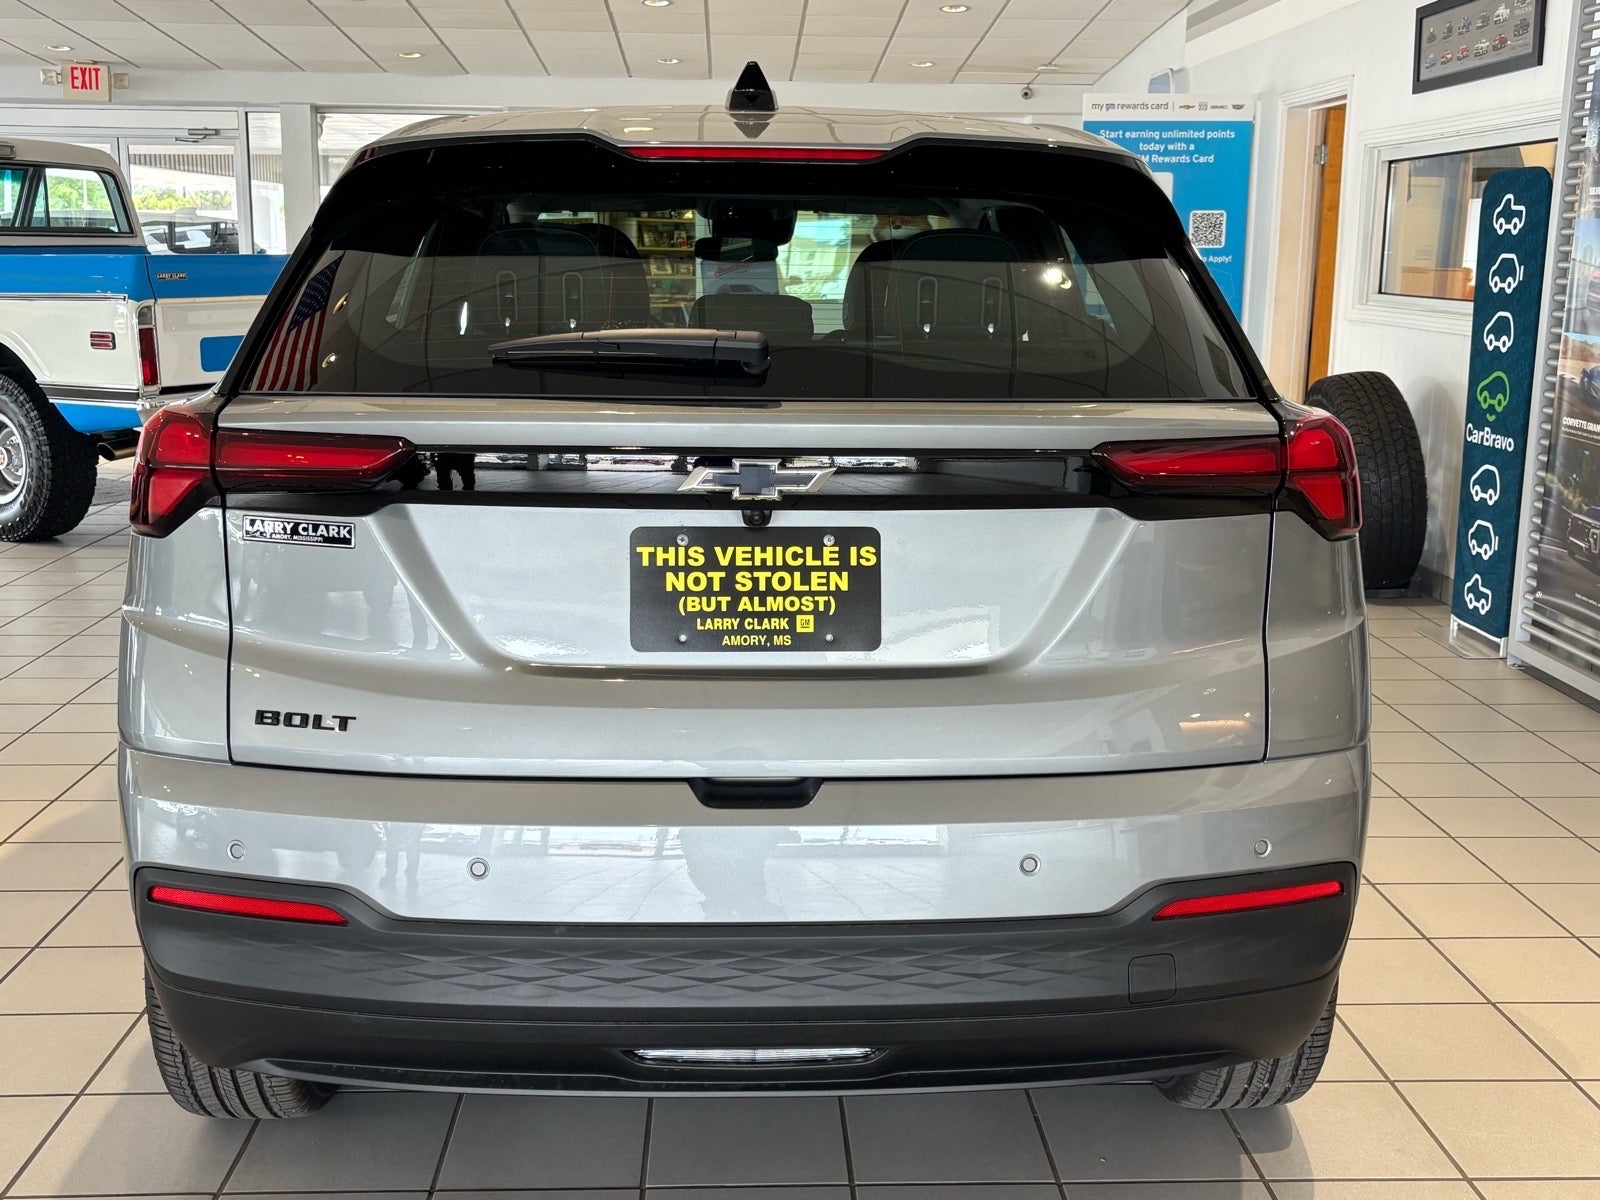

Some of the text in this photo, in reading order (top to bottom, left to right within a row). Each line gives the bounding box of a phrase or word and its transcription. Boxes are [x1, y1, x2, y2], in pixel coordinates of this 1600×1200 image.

[71, 66, 100, 90] EXIT
[1091, 102, 1104, 111] my
[1116, 102, 1150, 110] rewards
[1150, 102, 1169, 110] card
[1100, 129, 1236, 140] Start earning unlimited points
[1139, 142, 1195, 152] today with a
[1151, 154, 1190, 163] Rewards
[1192, 154, 1214, 163] Card
[1208, 255, 1232, 264] Apply!
[1466, 422, 1515, 452] CarBravo
[245, 518, 352, 539] LARRY CLARK
[271, 533, 324, 543] AMORY, MISSISSIPPI
[636, 546, 877, 567] THIS VEHICLE IS
[665, 571, 849, 592] NOT STOLEN
[678, 596, 836, 616] (BUT ALMOST)
[696, 617, 811, 630] LARRY CLARK GM
[722, 634, 792, 648] AMORY, MS
[254, 709, 357, 732] BOLT
